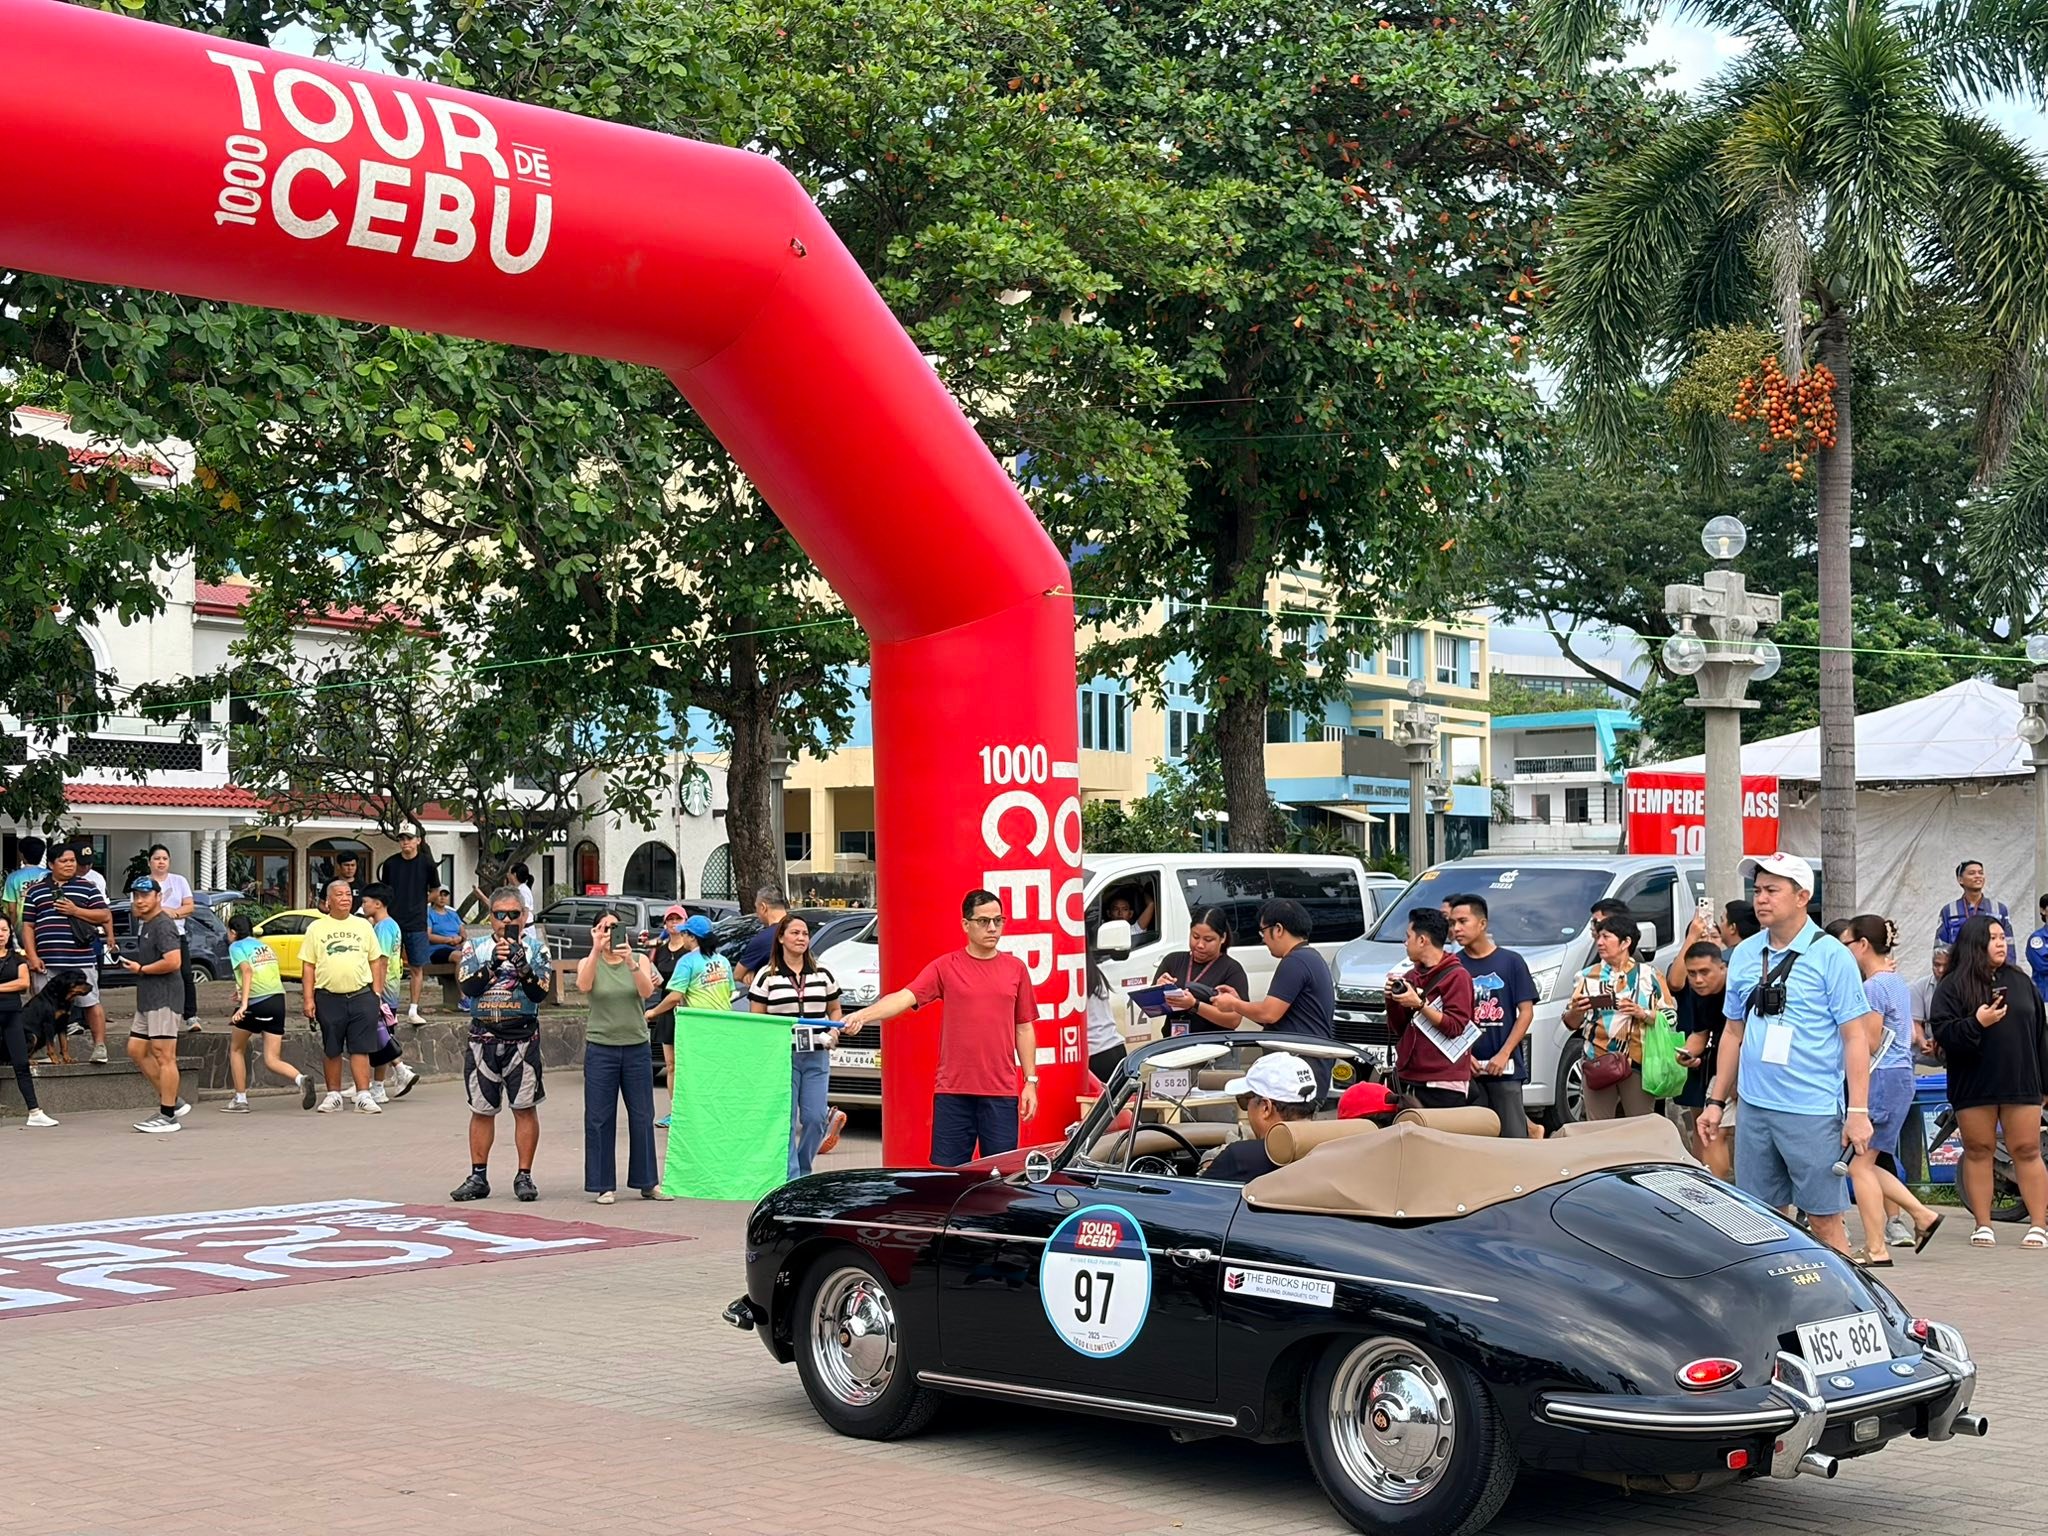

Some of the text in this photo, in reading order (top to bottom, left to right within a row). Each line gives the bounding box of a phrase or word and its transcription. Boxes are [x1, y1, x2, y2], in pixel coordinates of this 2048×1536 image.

[205, 49, 552, 180] TOUR DE
[213, 134, 268, 226] 1000
[270, 147, 553, 275] CEBU
[978, 744, 1048, 785] 1000
[1627, 787, 1779, 818] TEMPERE ASS
[321, 931, 362, 944] LACOSTE
[1063, 1026, 1078, 1064] DE
[1081, 1221, 1113, 1236] TOUR
[1083, 1234, 1116, 1248] CEBU
[1246, 1272, 1332, 1295] THE BRICKS HOTEL
[1767, 1261, 1829, 1277] PORSCHE
[1074, 1269, 1115, 1325] 97
[1085, 1340, 1118, 1352] KILOMETERS
[1808, 1322, 1883, 1366] NSC 882
